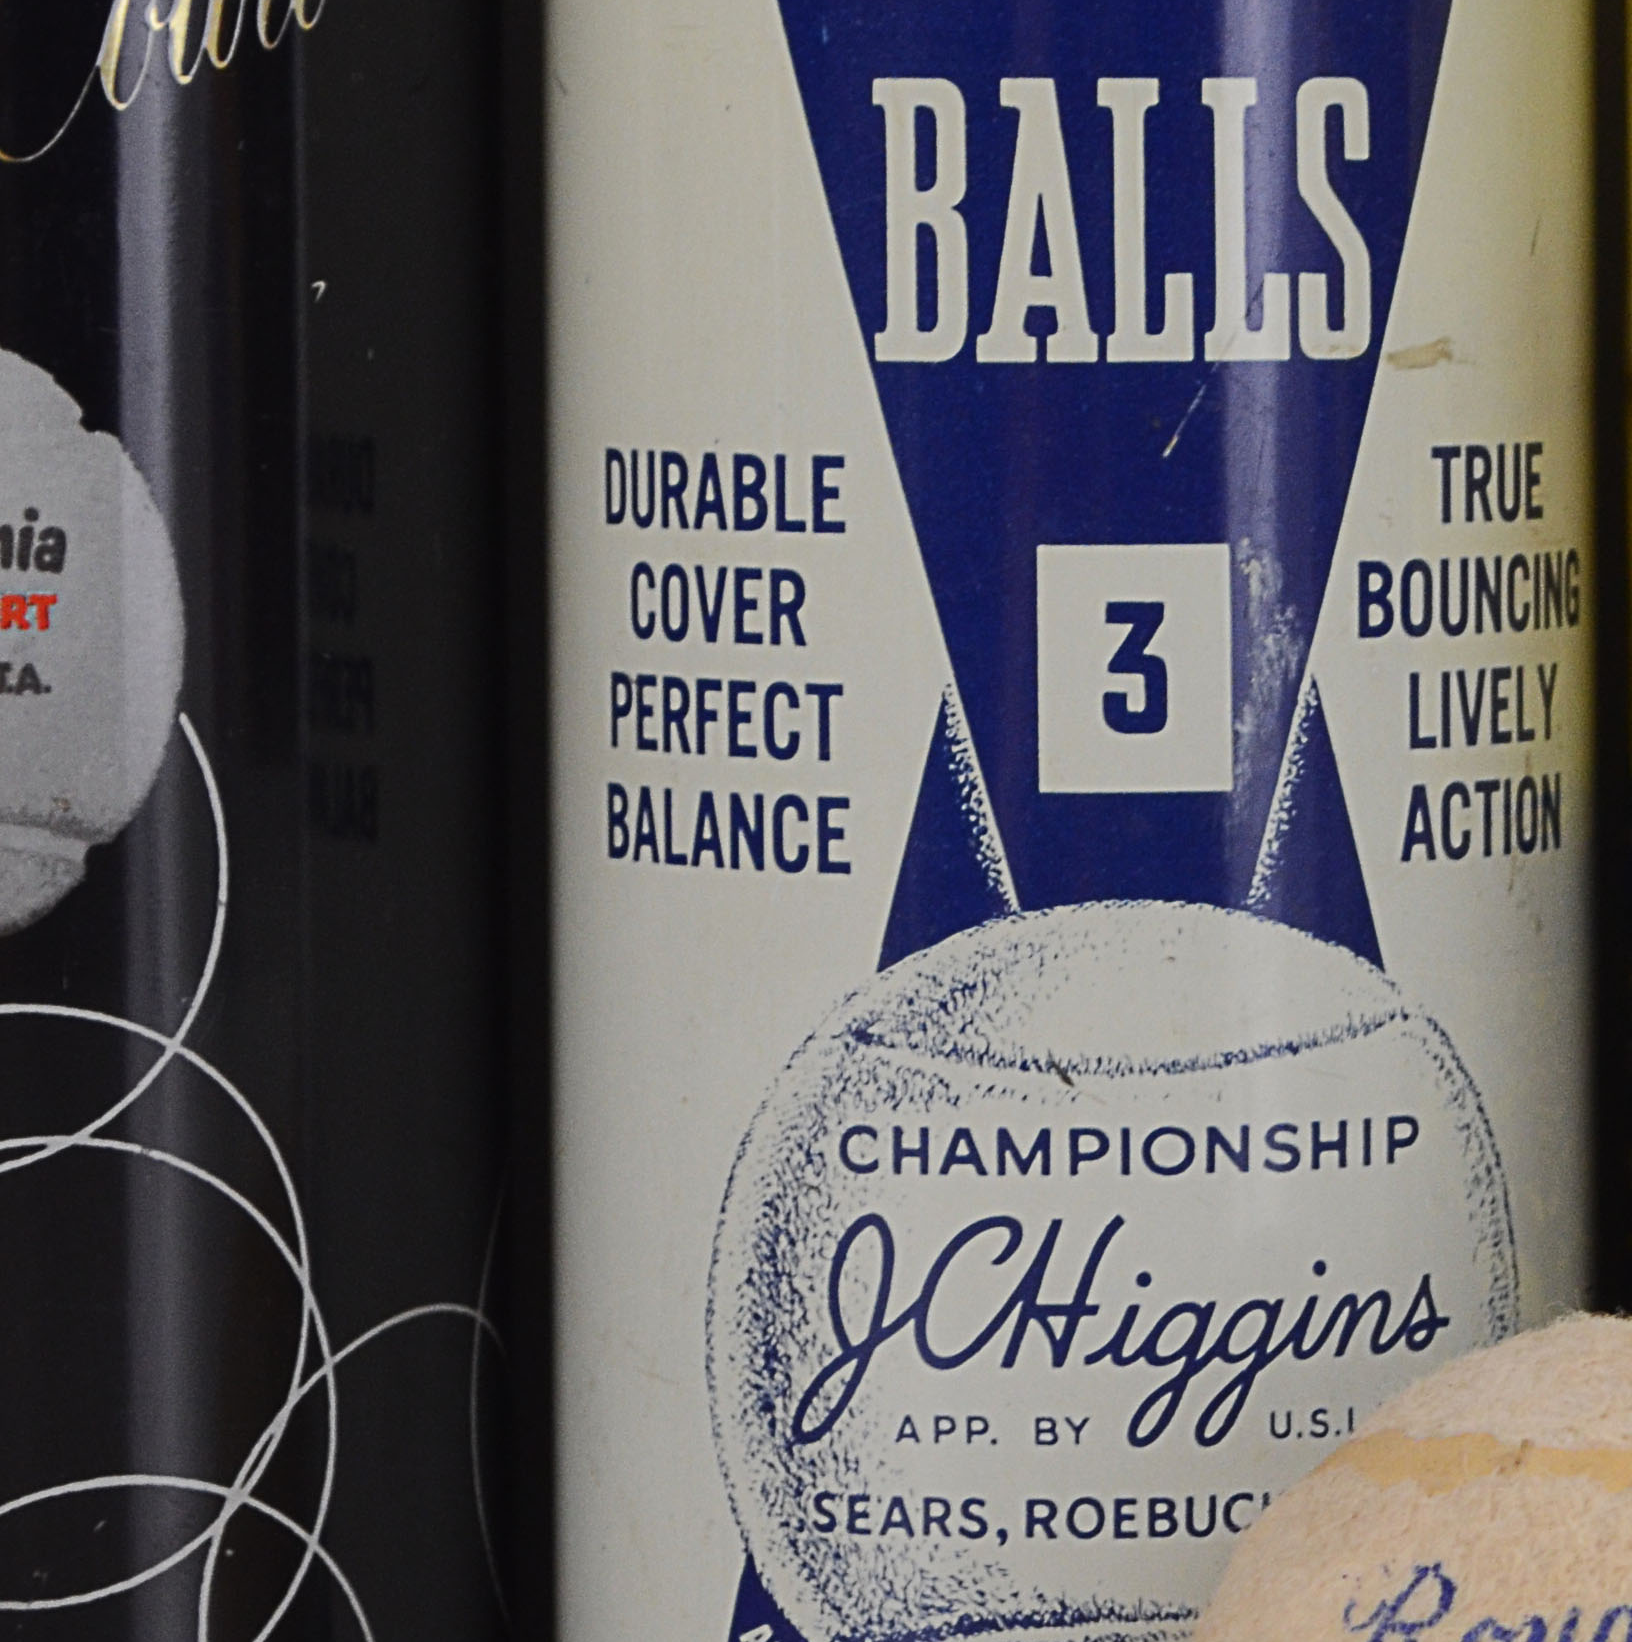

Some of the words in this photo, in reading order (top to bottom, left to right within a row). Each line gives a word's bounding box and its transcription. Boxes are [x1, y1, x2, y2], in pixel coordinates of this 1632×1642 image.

[871, 76, 1372, 364] BALLS
[604, 446, 847, 535] DURABLE
[1430, 441, 1545, 525] TRUE
[630, 560, 808, 647] COVER
[1357, 547, 1581, 640] BOUNCING
[1102, 601, 1169, 736] 3
[1408, 661, 1559, 751] LIVELY
[609, 670, 844, 763] PERFECT
[606, 780, 852, 876] BALANCE
[1400, 771, 1563, 862] ACTION
[838, 1114, 1421, 1178] CHAMPIONSHIP
[896, 1414, 999, 1446] APP.
[1034, 1415, 1090, 1446] BY
[811, 1489, 1009, 1546] SEARS,
[1026, 1489, 1274, 1540] ROEBUC
